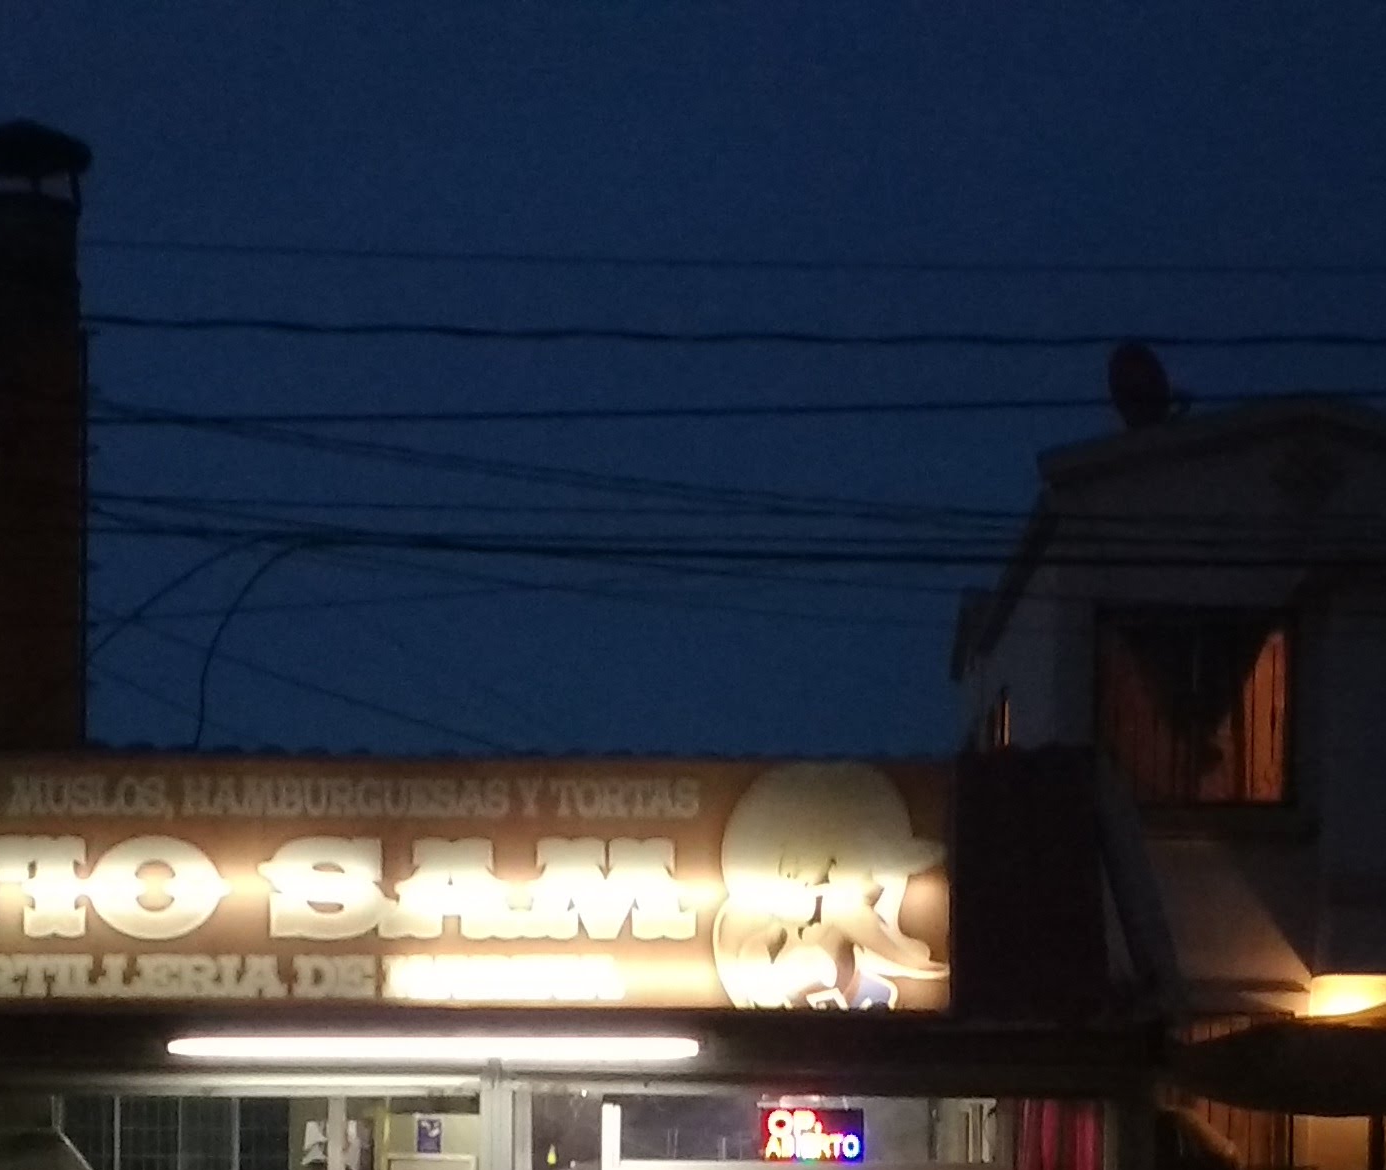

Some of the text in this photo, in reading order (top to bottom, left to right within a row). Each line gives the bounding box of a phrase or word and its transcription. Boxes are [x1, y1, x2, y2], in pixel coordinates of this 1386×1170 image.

[7, 775, 174, 820] MUSLOS,
[180, 775, 510, 818] HAMBURGUESAS
[515, 775, 544, 818] Y
[550, 776, 700, 819] TORTAS
[257, 836, 698, 941] SAM
[293, 953, 378, 999] DE
